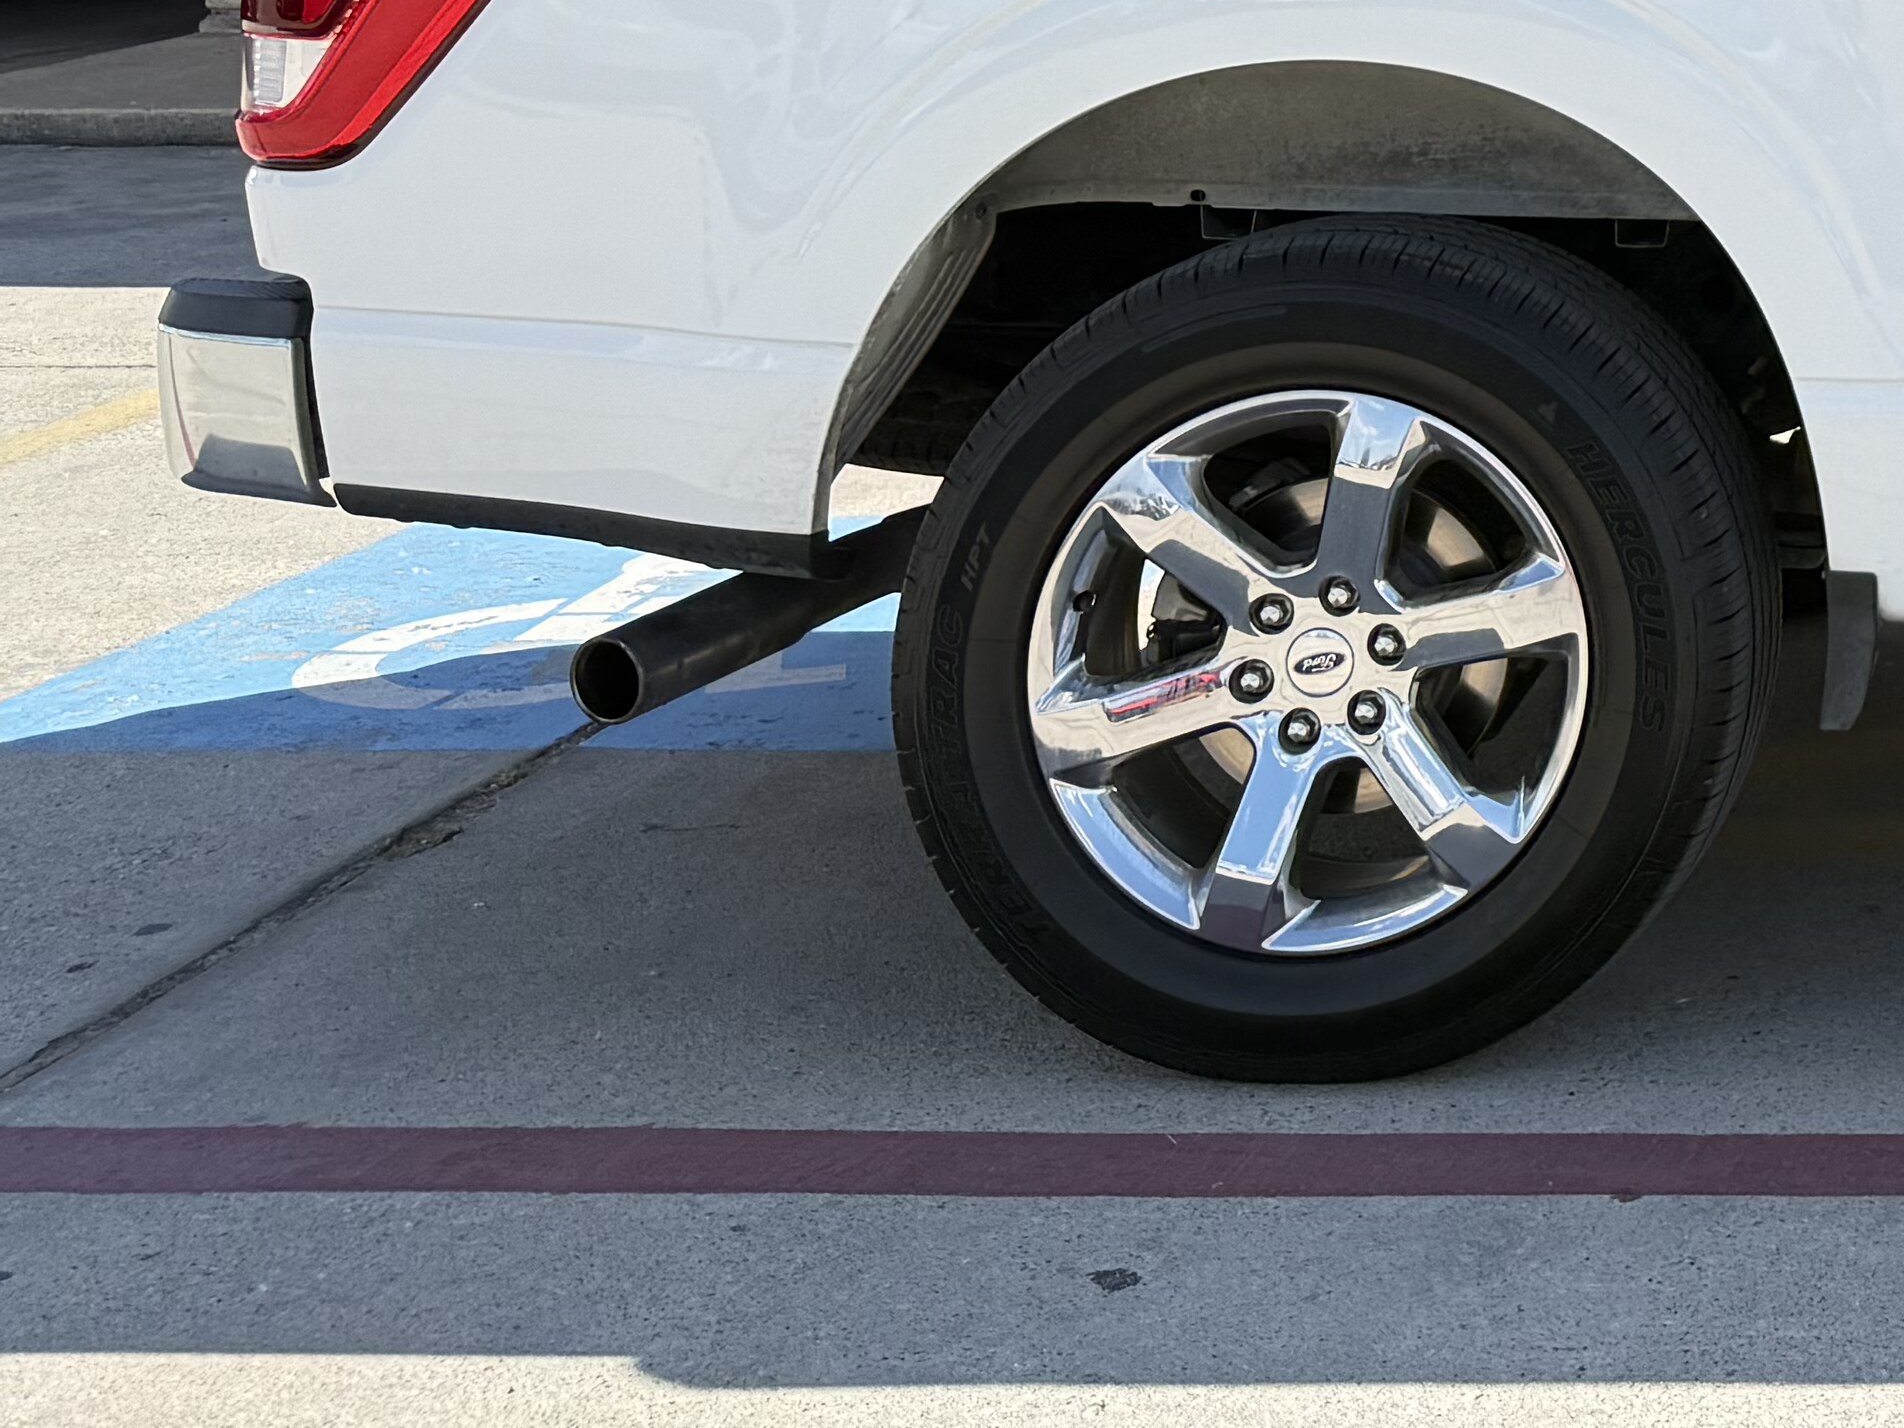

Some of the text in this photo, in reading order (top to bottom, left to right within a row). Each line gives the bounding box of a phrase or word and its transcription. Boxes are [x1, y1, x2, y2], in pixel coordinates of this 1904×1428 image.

[925, 603, 965, 763] TRAC
[960, 523, 995, 593] HPT
[1302, 653, 1336, 672] Ford
[1563, 439, 1668, 734] HERCULES
